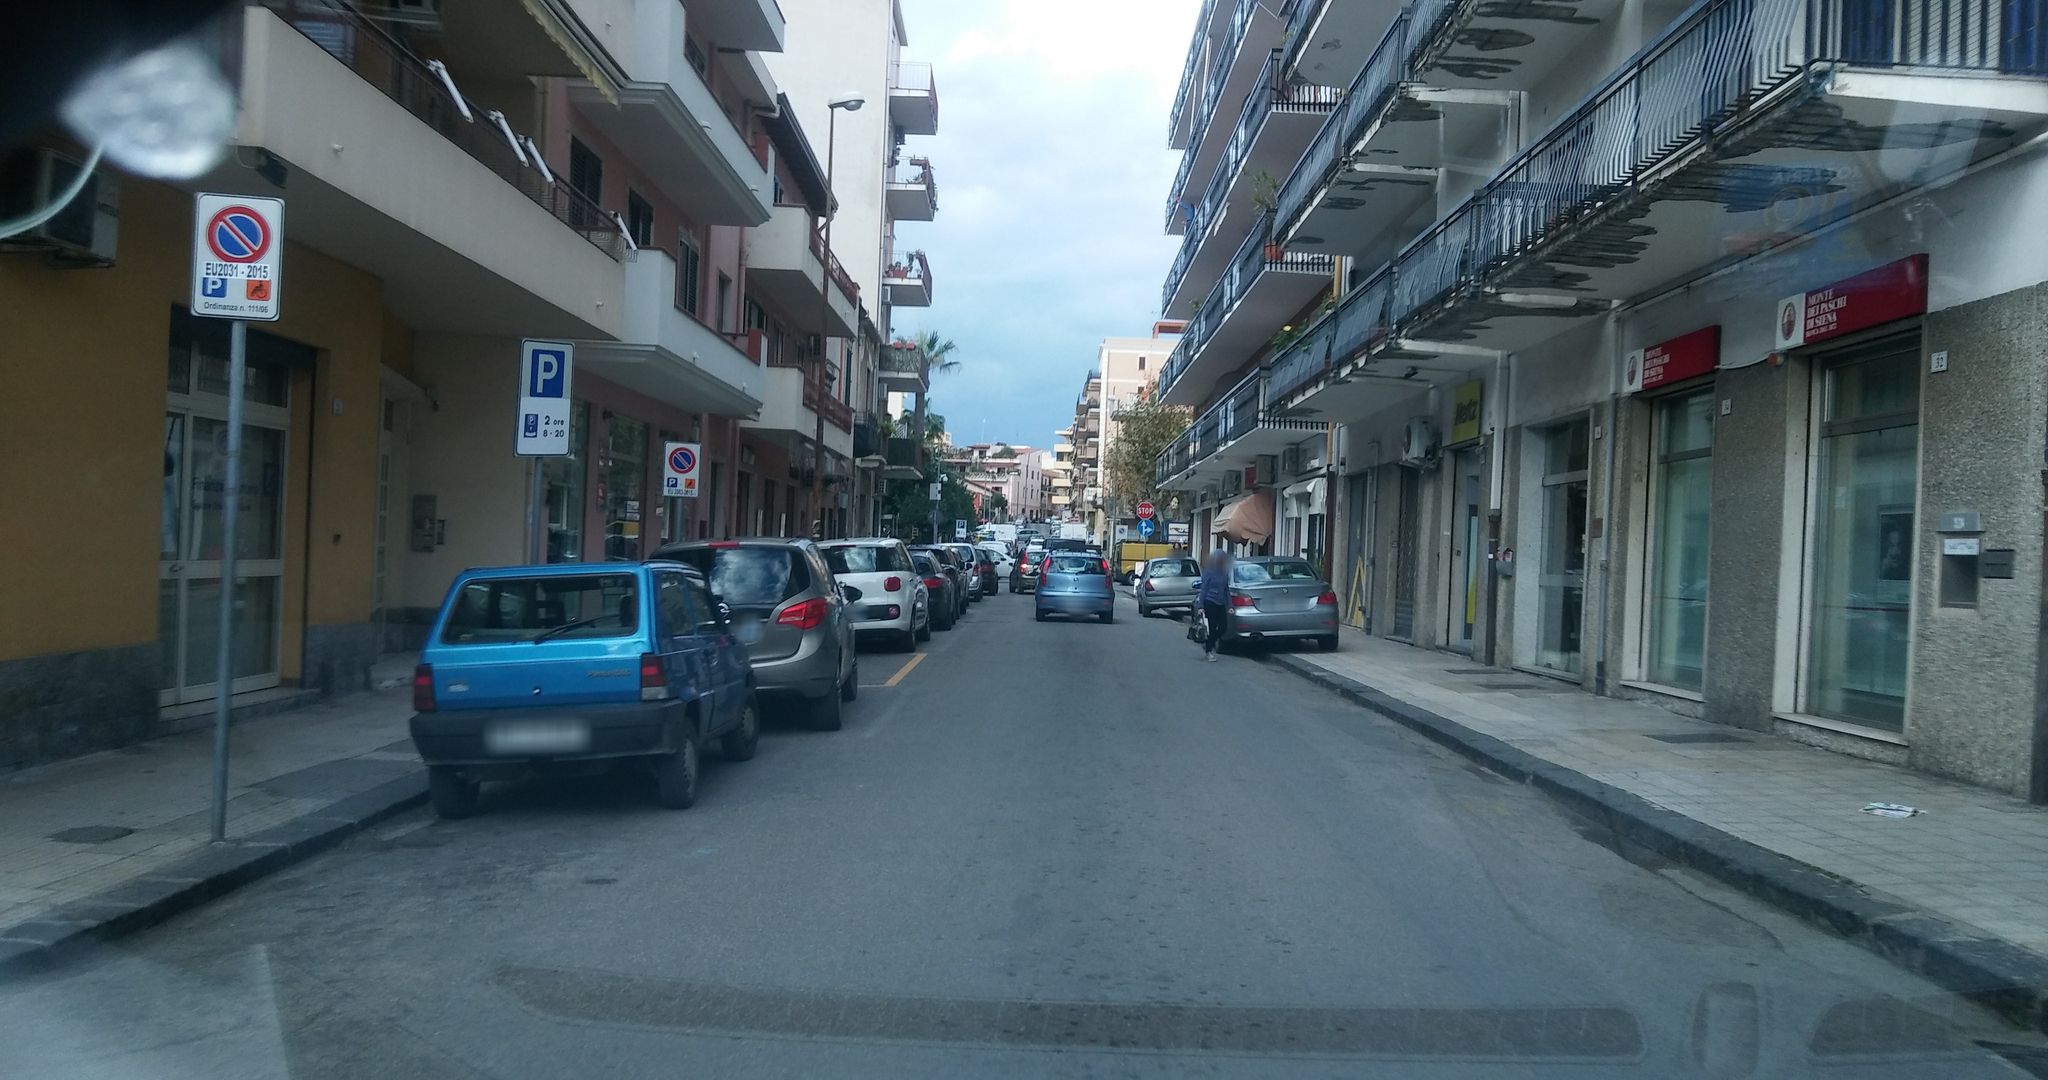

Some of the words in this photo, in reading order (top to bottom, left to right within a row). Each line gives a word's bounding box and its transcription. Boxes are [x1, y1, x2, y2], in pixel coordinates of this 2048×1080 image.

[205, 263, 239, 276] EU2031
[246, 265, 269, 279] 2015
[204, 302, 238, 311] Ordinanza
[537, 353, 558, 393] P
[544, 415, 551, 426] 2
[555, 430, 564, 438] 20
[669, 479, 676, 487] P
[1138, 507, 1153, 515] STOP
